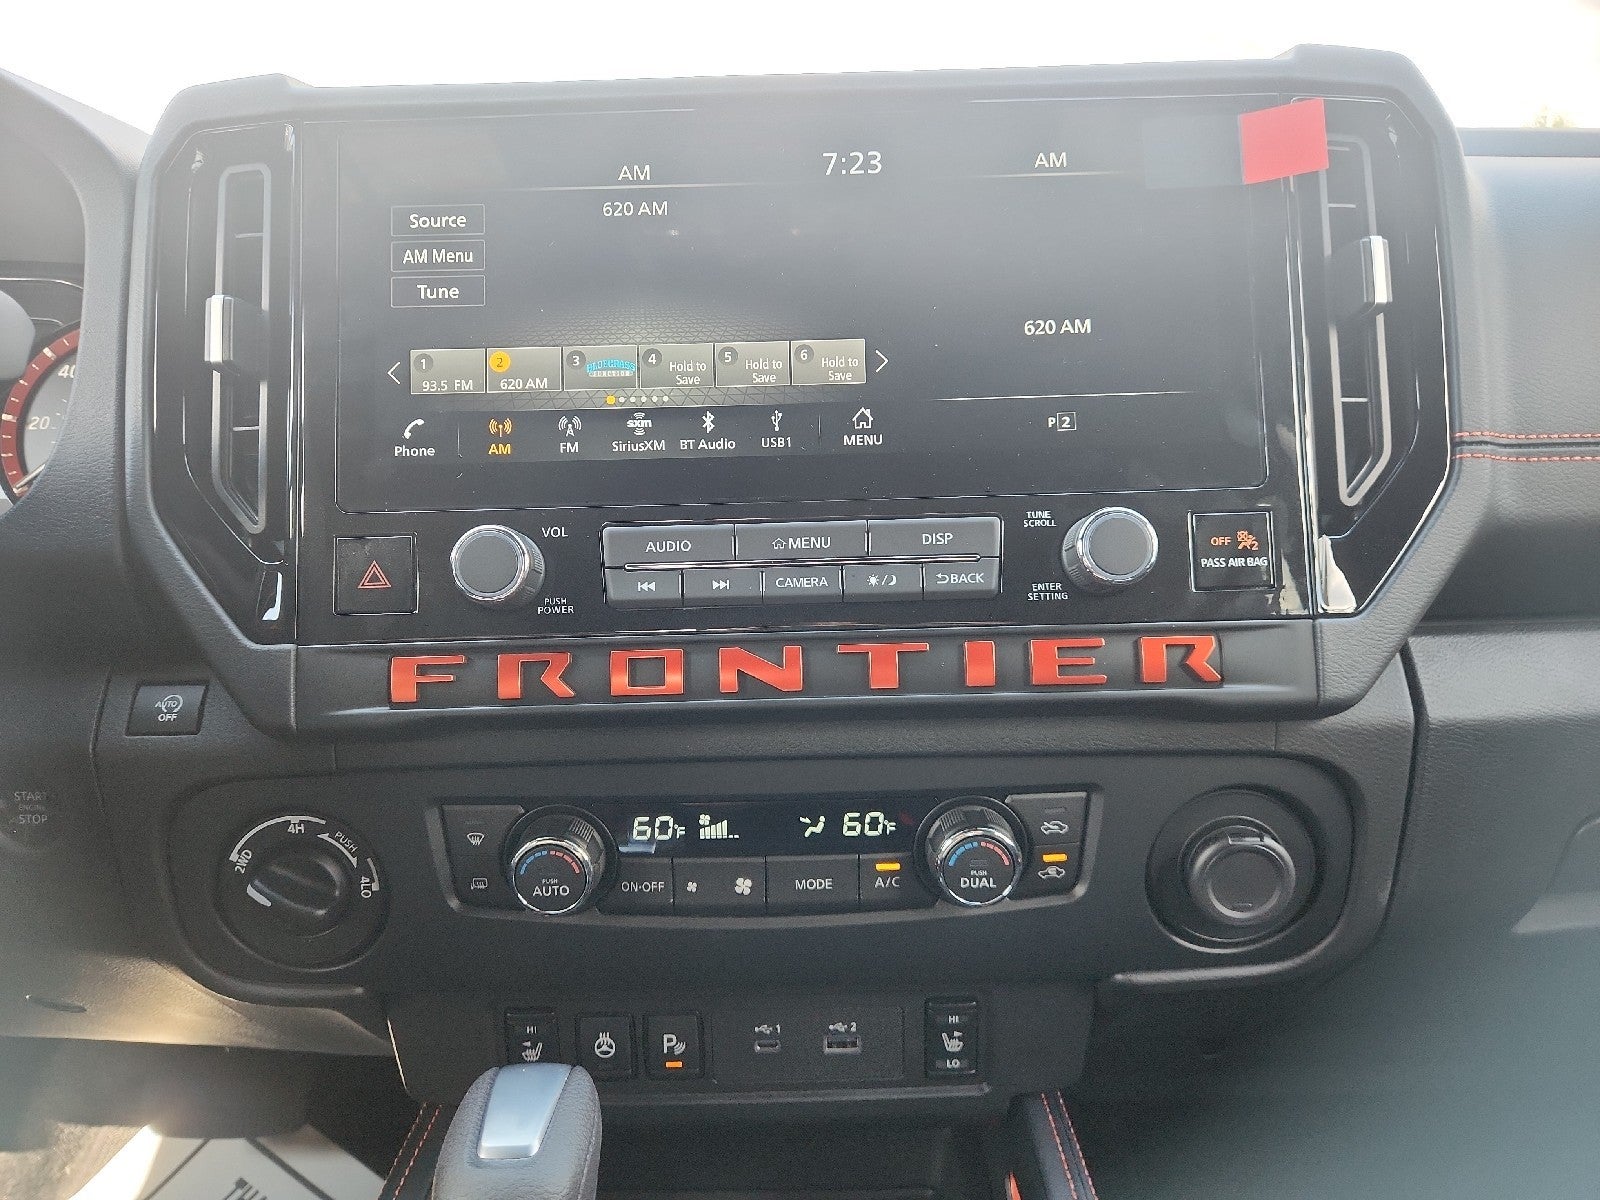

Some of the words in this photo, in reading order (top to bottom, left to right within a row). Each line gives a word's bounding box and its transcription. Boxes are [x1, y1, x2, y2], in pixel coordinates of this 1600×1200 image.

[822, 152, 883, 175] 7:23
[1034, 152, 1067, 169] AM
[618, 165, 651, 181] AM
[602, 201, 633, 217] 620
[638, 201, 668, 217] AM
[409, 212, 467, 229] Source
[403, 249, 428, 264] AM
[432, 248, 473, 264] Menu
[417, 284, 459, 300] Tune
[1024, 319, 1056, 335] 620
[1060, 318, 1091, 334] AM
[572, 355, 580, 367] 3
[648, 353, 657, 365] 4
[724, 351, 732, 363] 5
[800, 349, 808, 361] 6
[420, 358, 427, 369] 1
[496, 357, 504, 368] 2
[669, 360, 693, 373] Hold
[695, 361, 707, 373] to
[745, 358, 769, 370] Hold
[771, 359, 783, 370] to
[821, 356, 845, 368] Hold
[847, 357, 859, 368] to
[676, 375, 701, 386] Save
[752, 373, 777, 384] Save
[828, 371, 852, 382] Save
[422, 379, 448, 392] 93.5
[454, 379, 473, 391] FM
[500, 378, 523, 390] 620
[525, 378, 548, 389] AM
[28, 416, 50, 430] 20
[612, 439, 666, 452] SiriusXM
[680, 439, 695, 450] BT
[698, 438, 736, 450] Audio
[761, 436, 792, 448] USB1
[843, 434, 883, 446] MENU
[394, 443, 436, 458] Phone
[488, 443, 511, 455] AM
[560, 442, 579, 453] FM
[1026, 510, 1052, 519] TUNE
[1023, 519, 1057, 528] SCROLL
[541, 526, 569, 538] VOL
[788, 536, 832, 550] MENU
[922, 532, 954, 546] DISP
[1210, 536, 1232, 546] OFF
[645, 539, 692, 554] AUDIO
[1200, 557, 1226, 568] PASS
[1228, 557, 1246, 567] AIR
[1246, 556, 1268, 567] BAG
[775, 576, 829, 589] CAMERA
[950, 571, 984, 584] BACK
[1032, 582, 1062, 591] ENTER
[544, 597, 568, 605] PUSH
[1027, 592, 1069, 601] SETTING
[537, 605, 575, 615] POWER
[389, 634, 1223, 704] FRONTIER
[154, 700, 178, 708] AUTO
[158, 713, 178, 722] OFF
[19, 814, 48, 824] STOP
[287, 823, 305, 834] 4H
[334, 830, 358, 853] PUSH
[234, 849, 253, 874] 2WD
[360, 876, 372, 899] 4LO
[795, 877, 833, 890] MODE
[875, 876, 901, 889] A/C
[960, 876, 997, 888] DUAL
[533, 884, 570, 897] AUTO
[948, 1015, 959, 1024] HI
[526, 1025, 537, 1034] HI
[946, 1058, 960, 1068] LO
